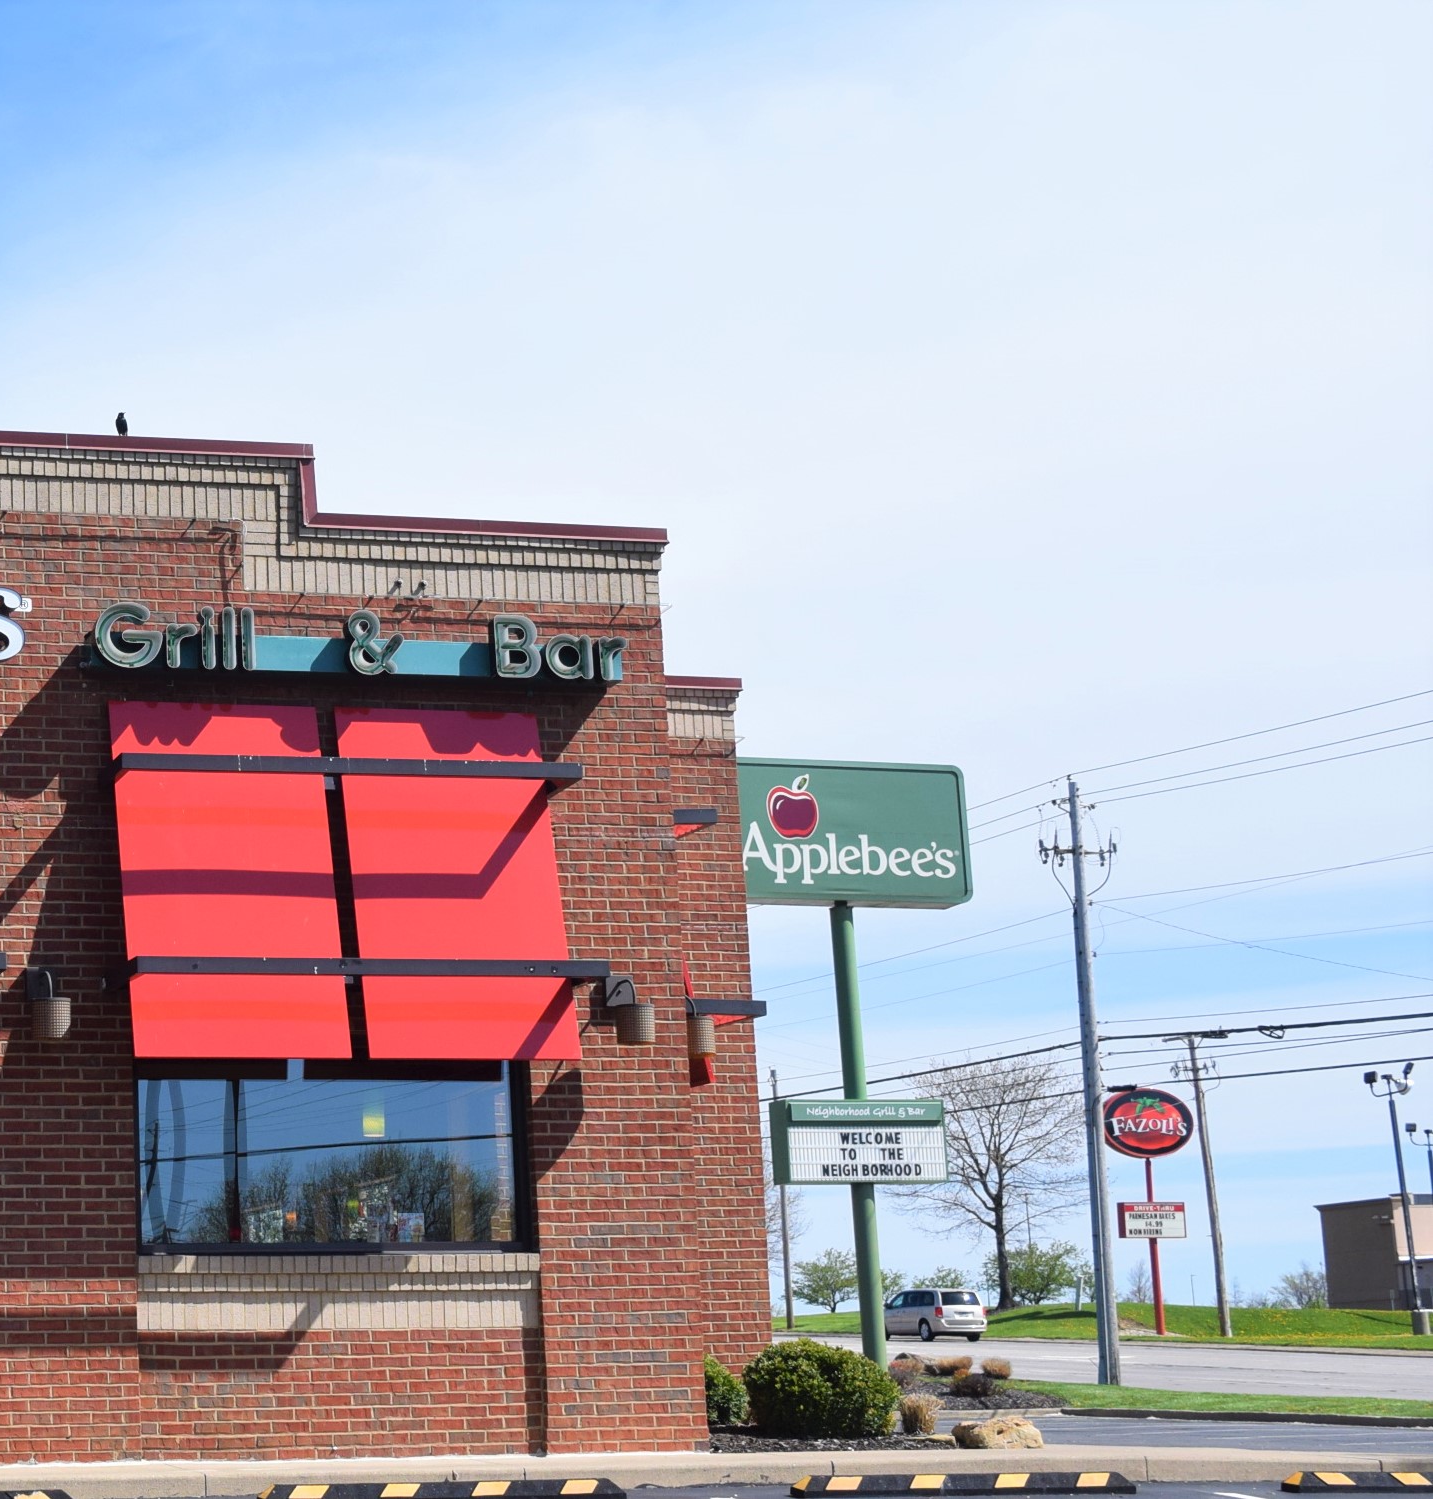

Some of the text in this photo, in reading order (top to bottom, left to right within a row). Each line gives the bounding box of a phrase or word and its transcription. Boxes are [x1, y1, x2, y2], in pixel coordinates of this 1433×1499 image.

[94, 602, 628, 682] Grill & Bar
[742, 821, 957, 884] Applebee's
[806, 1105, 926, 1118] Neighborhood Grill & Bar
[840, 1132, 902, 1145] WELCOME
[841, 1148, 904, 1161] TO THE
